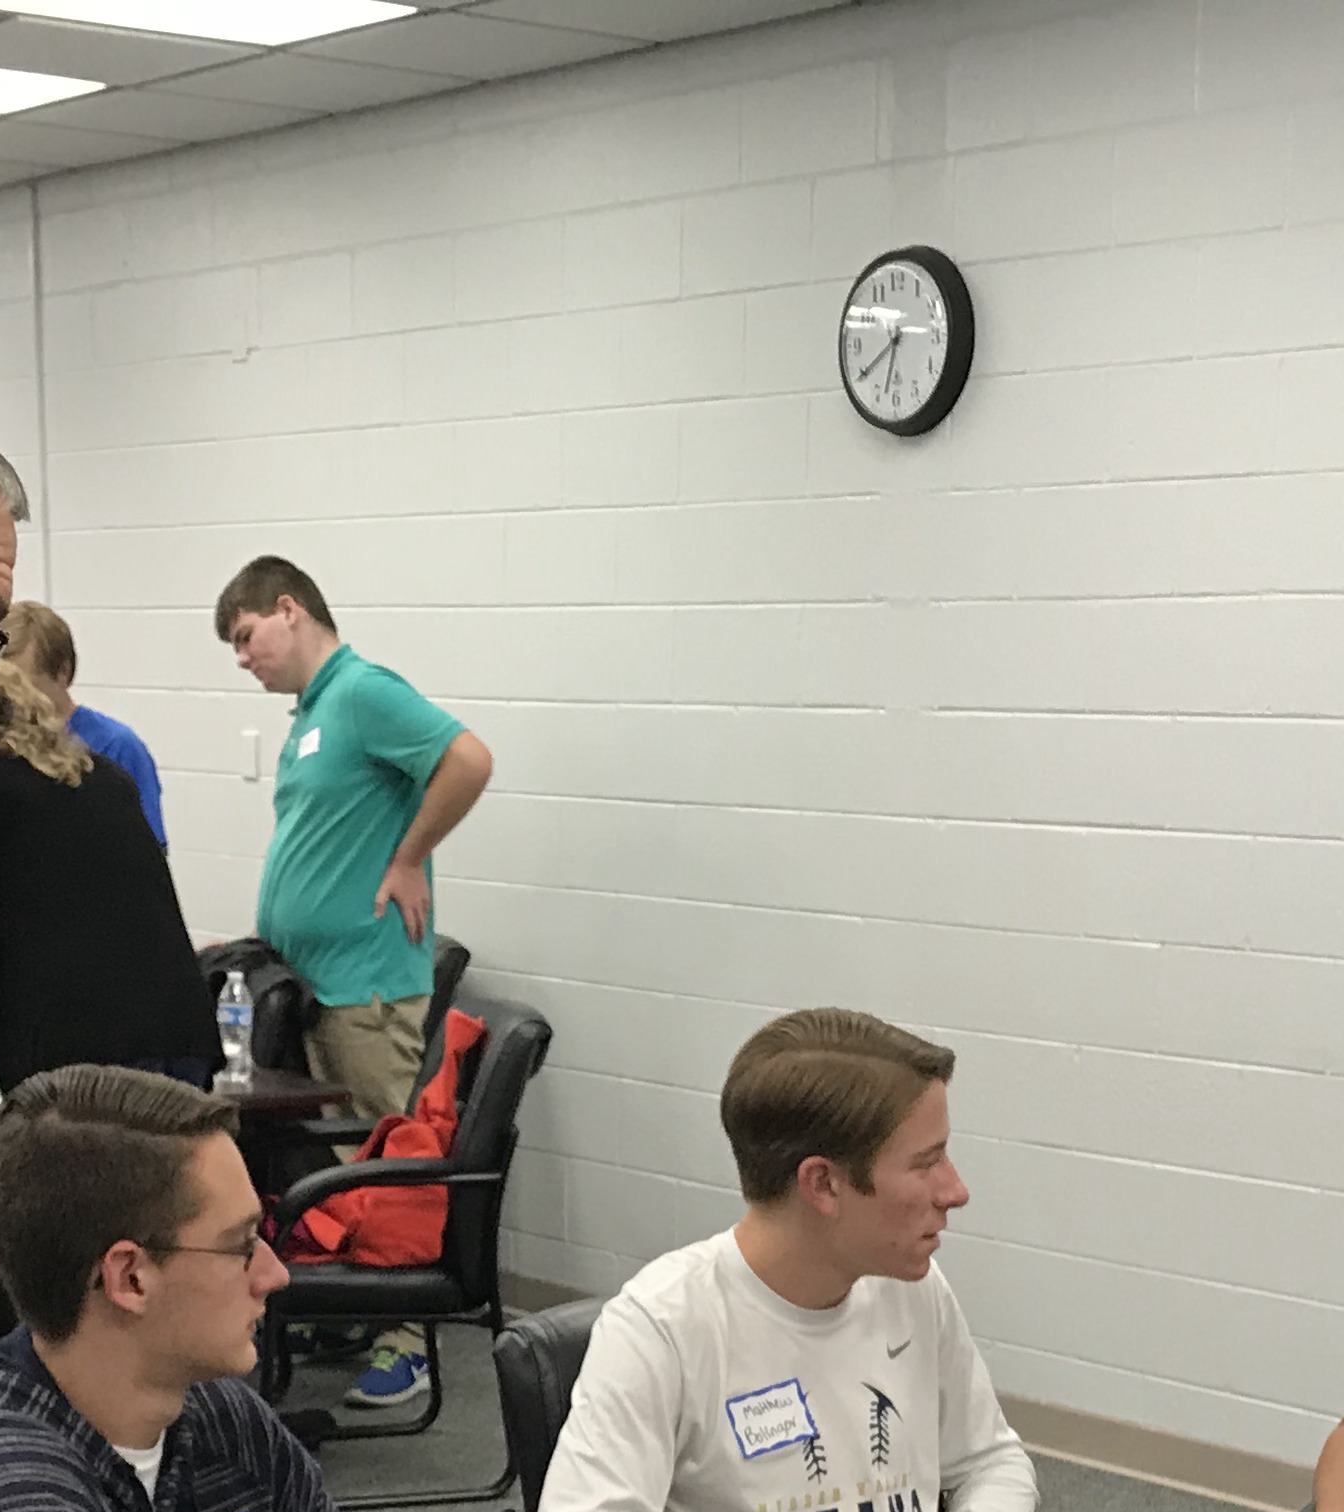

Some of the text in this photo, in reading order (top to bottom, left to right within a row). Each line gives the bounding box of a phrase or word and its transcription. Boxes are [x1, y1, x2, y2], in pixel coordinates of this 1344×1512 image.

[890, 271, 905, 292] 12
[872, 282, 886, 303] 11
[853, 336, 862, 356] 9
[742, 1396, 793, 1420] Matthew
